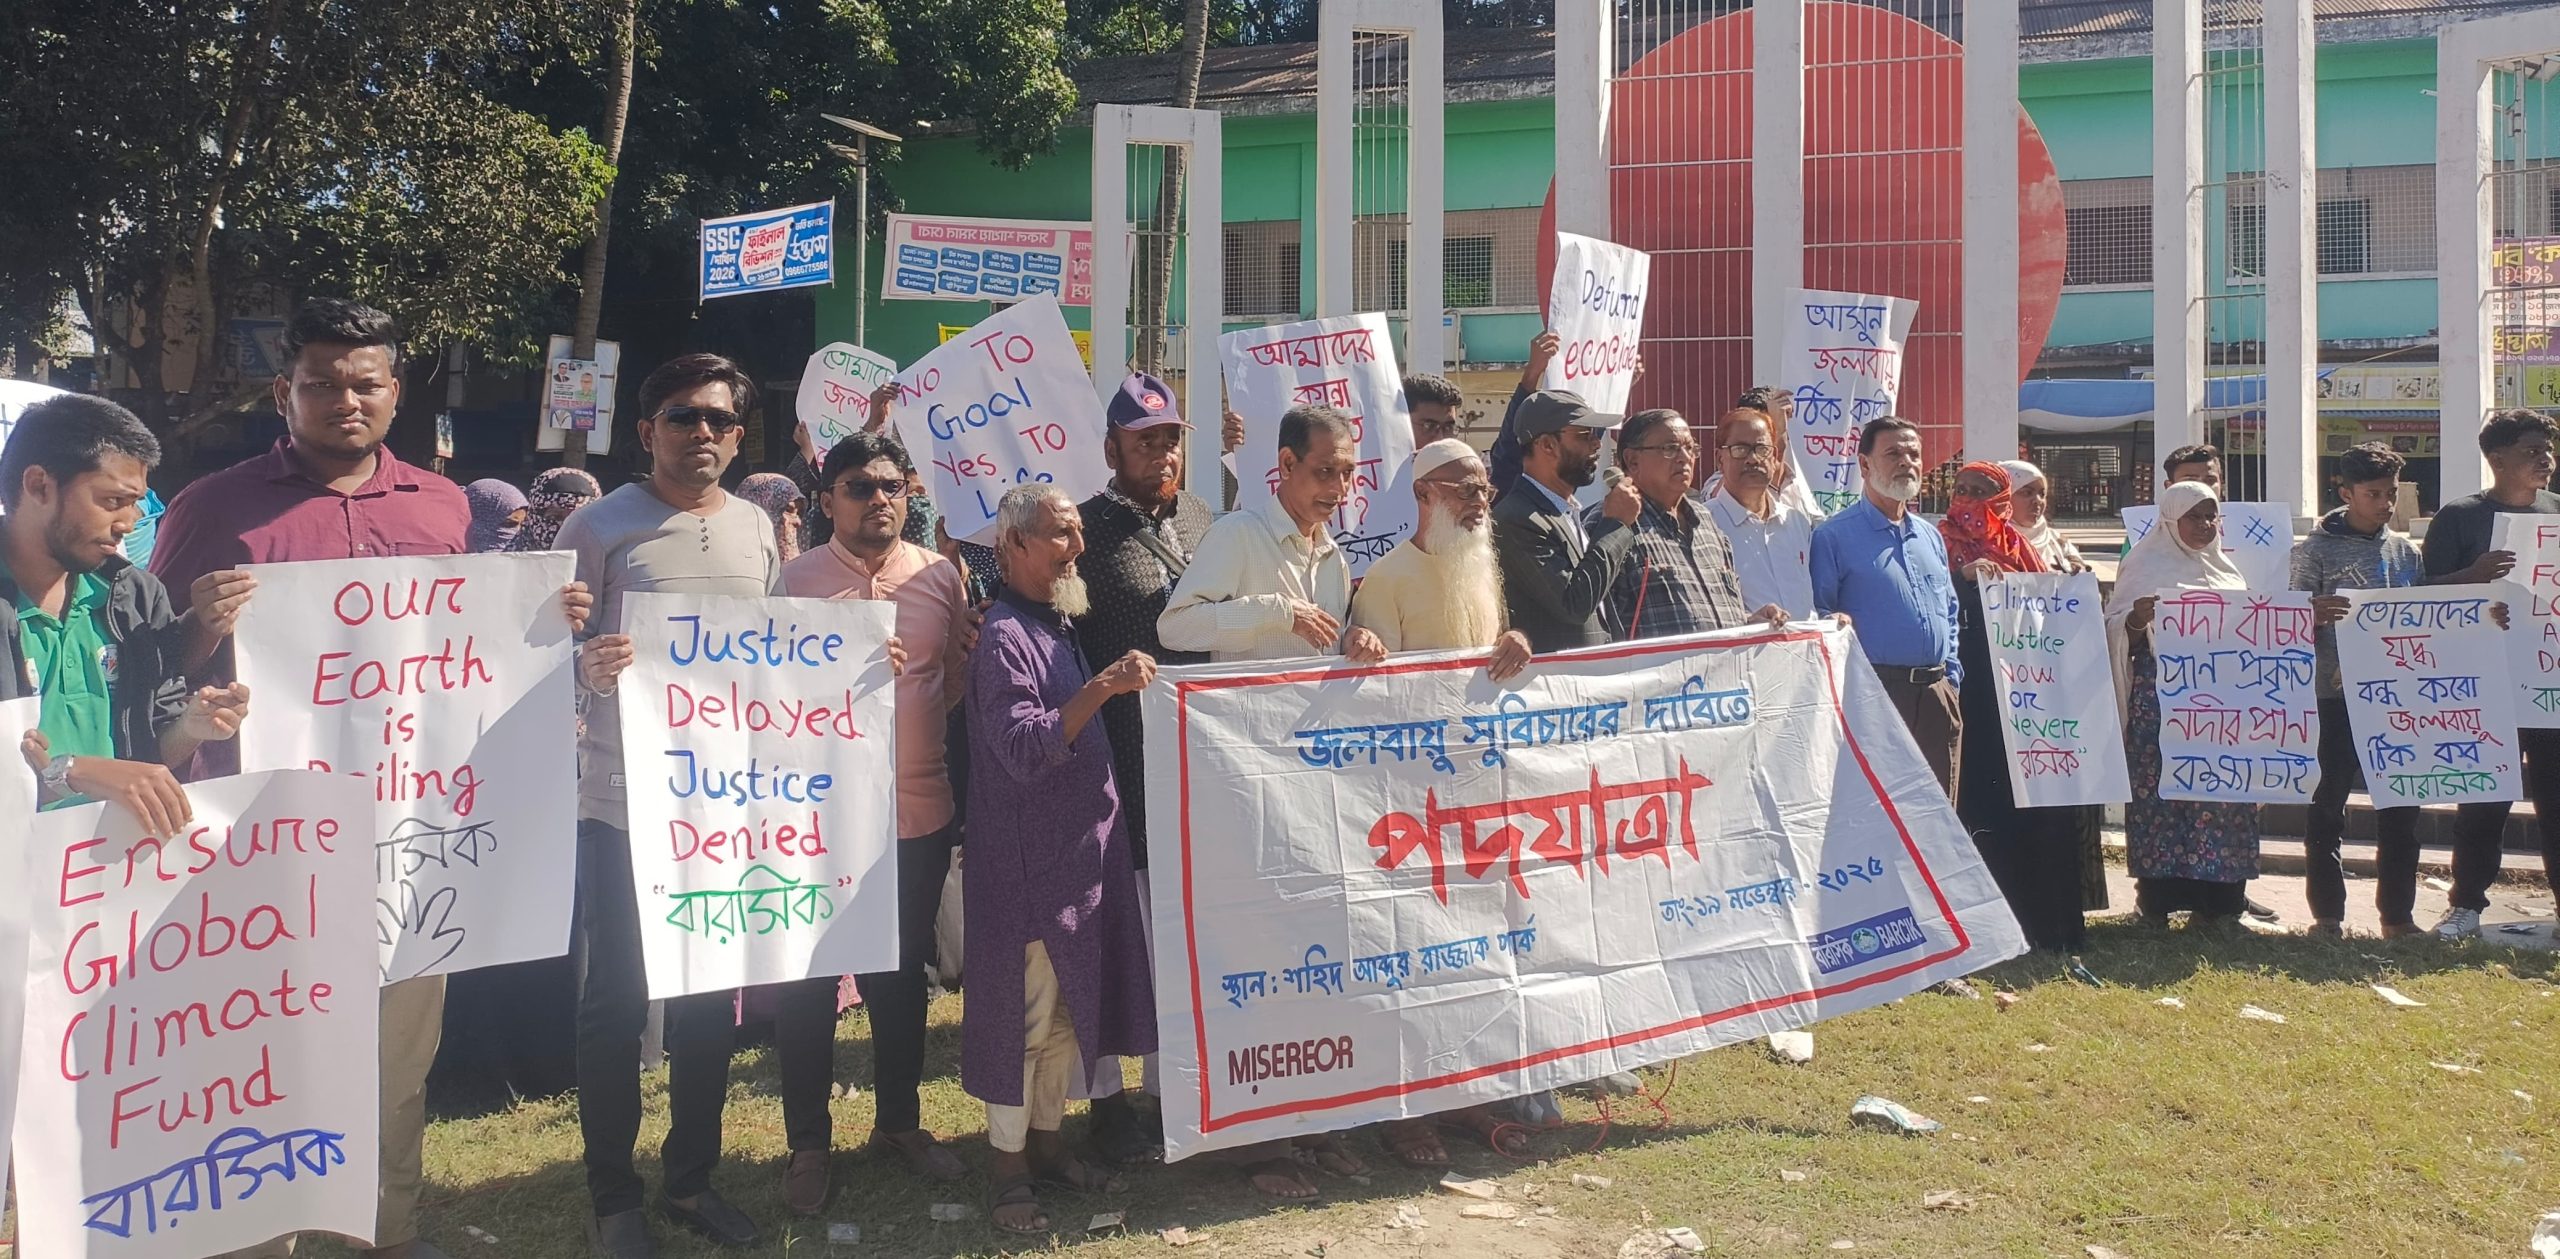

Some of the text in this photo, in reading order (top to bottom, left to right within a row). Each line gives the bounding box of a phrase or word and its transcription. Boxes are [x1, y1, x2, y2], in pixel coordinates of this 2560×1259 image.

[705, 226, 740, 251] SSC
[709, 266, 736, 281] 2026
[1247, 328, 1376, 368] আমাদের
[1804, 305, 1887, 346] আসুন
[901, 368, 940, 406] NO
[970, 331, 1034, 371] TO
[1809, 347, 1897, 395] জলবায়ু
[927, 377, 1032, 440] Goal
[1794, 381, 1843, 425] ঠিক
[932, 423, 1067, 486] Yes TO
[1985, 584, 2080, 613] Climate
[2163, 591, 2231, 643] নদী
[2356, 599, 2489, 632] তোমাদের
[667, 614, 843, 667] Justice
[2381, 634, 2437, 671] যুদ্ধ
[312, 635, 494, 706] Earth
[2417, 676, 2480, 703] করো
[384, 706, 416, 745] is
[666, 681, 866, 741] Delayed
[1295, 674, 1751, 775] জলবায়ু সুবিচারের দাবিতে
[2167, 693, 2242, 746] নদীর
[2387, 708, 2504, 747] জলবায়ু
[664, 749, 833, 806] Justice
[2261, 749, 2316, 794] চাই
[668, 811, 829, 864] Denied
[1367, 753, 1715, 907] পদযাত্রা
[59, 816, 340, 908] Ensure
[1724, 876, 1797, 911] নভেম্বর
[1817, 856, 1884, 893] ২০২৫
[62, 874, 317, 995] Global
[1282, 943, 1344, 996] শহিদ
[1353, 949, 1410, 990] আব্দুর
[1418, 935, 1490, 975] রাজ্জাক
[1497, 912, 1537, 958] পার্ক
[1875, 917, 1922, 951] BARCIK
[60, 968, 333, 1082] Climate
[1227, 1034, 1354, 1095] MISEREOR
[110, 1043, 288, 1150] Fund
